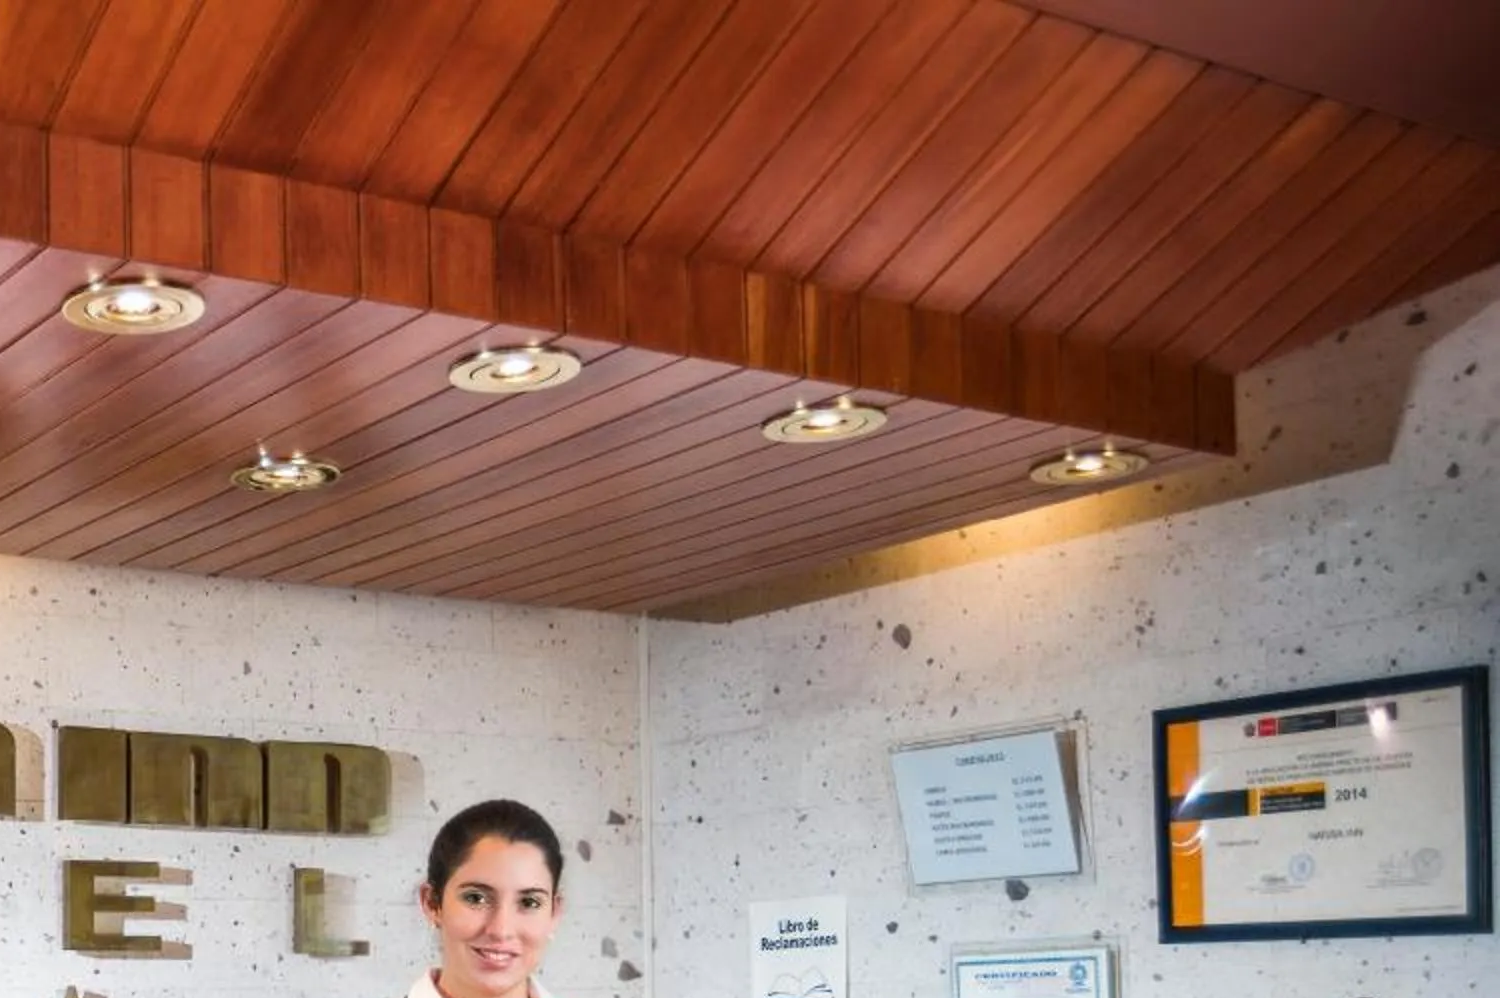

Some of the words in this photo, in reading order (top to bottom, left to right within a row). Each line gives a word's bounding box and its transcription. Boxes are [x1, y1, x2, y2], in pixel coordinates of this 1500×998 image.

[57, 724, 392, 834] inn
[1335, 787, 1367, 802] 2014
[778, 919, 804, 935] Libro
[806, 917, 819, 932] de
[761, 934, 838, 951] Reclamaciones
